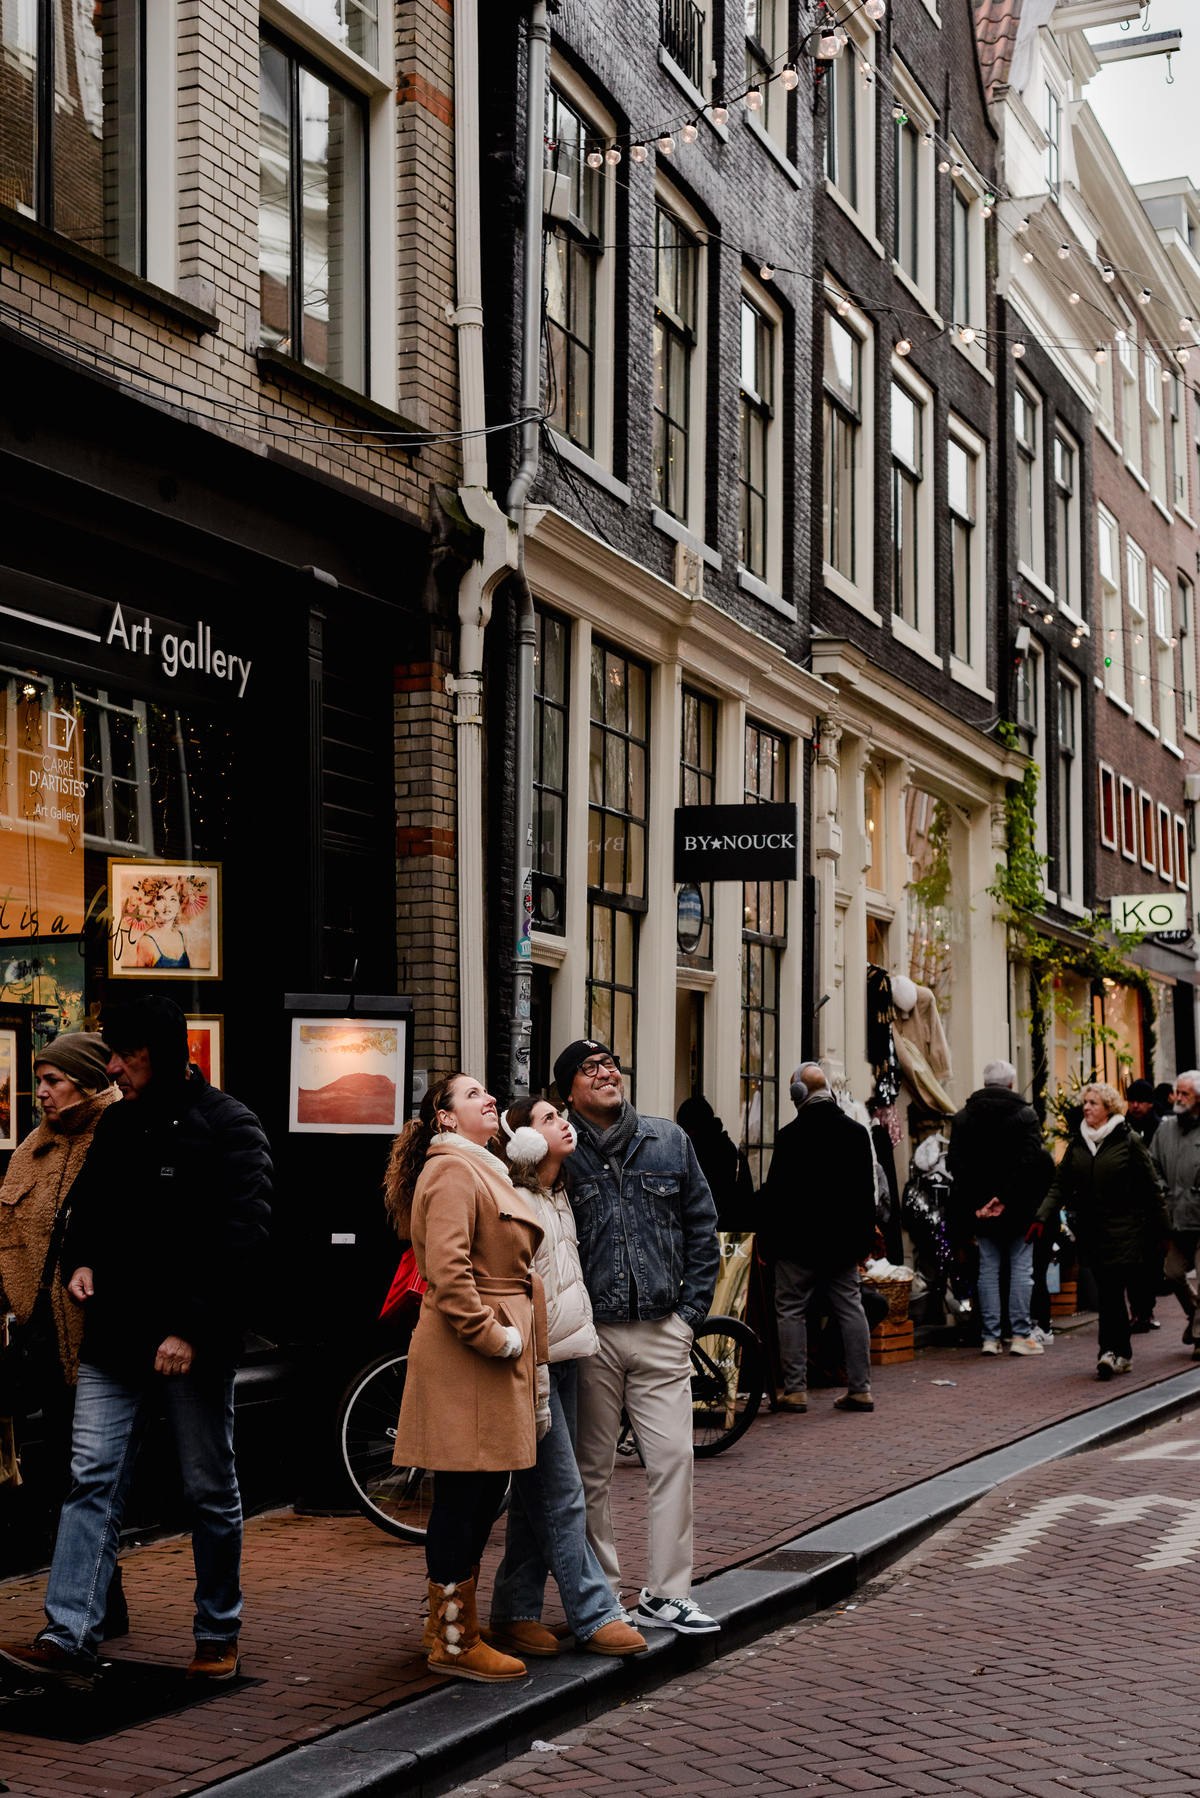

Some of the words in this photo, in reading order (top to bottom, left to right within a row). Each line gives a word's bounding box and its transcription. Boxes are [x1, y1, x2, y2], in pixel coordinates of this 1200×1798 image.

[106, 602, 153, 655] Art
[161, 620, 252, 698] gallery
[42, 754, 74, 777] CARRÉ
[35, 803, 48, 817] Art
[50, 806, 80, 825] Gallery
[684, 836, 712, 851] BY
[722, 834, 796, 850] NOUCK
[51, 915, 69, 933] a
[720, 1243, 748, 1258] CK
